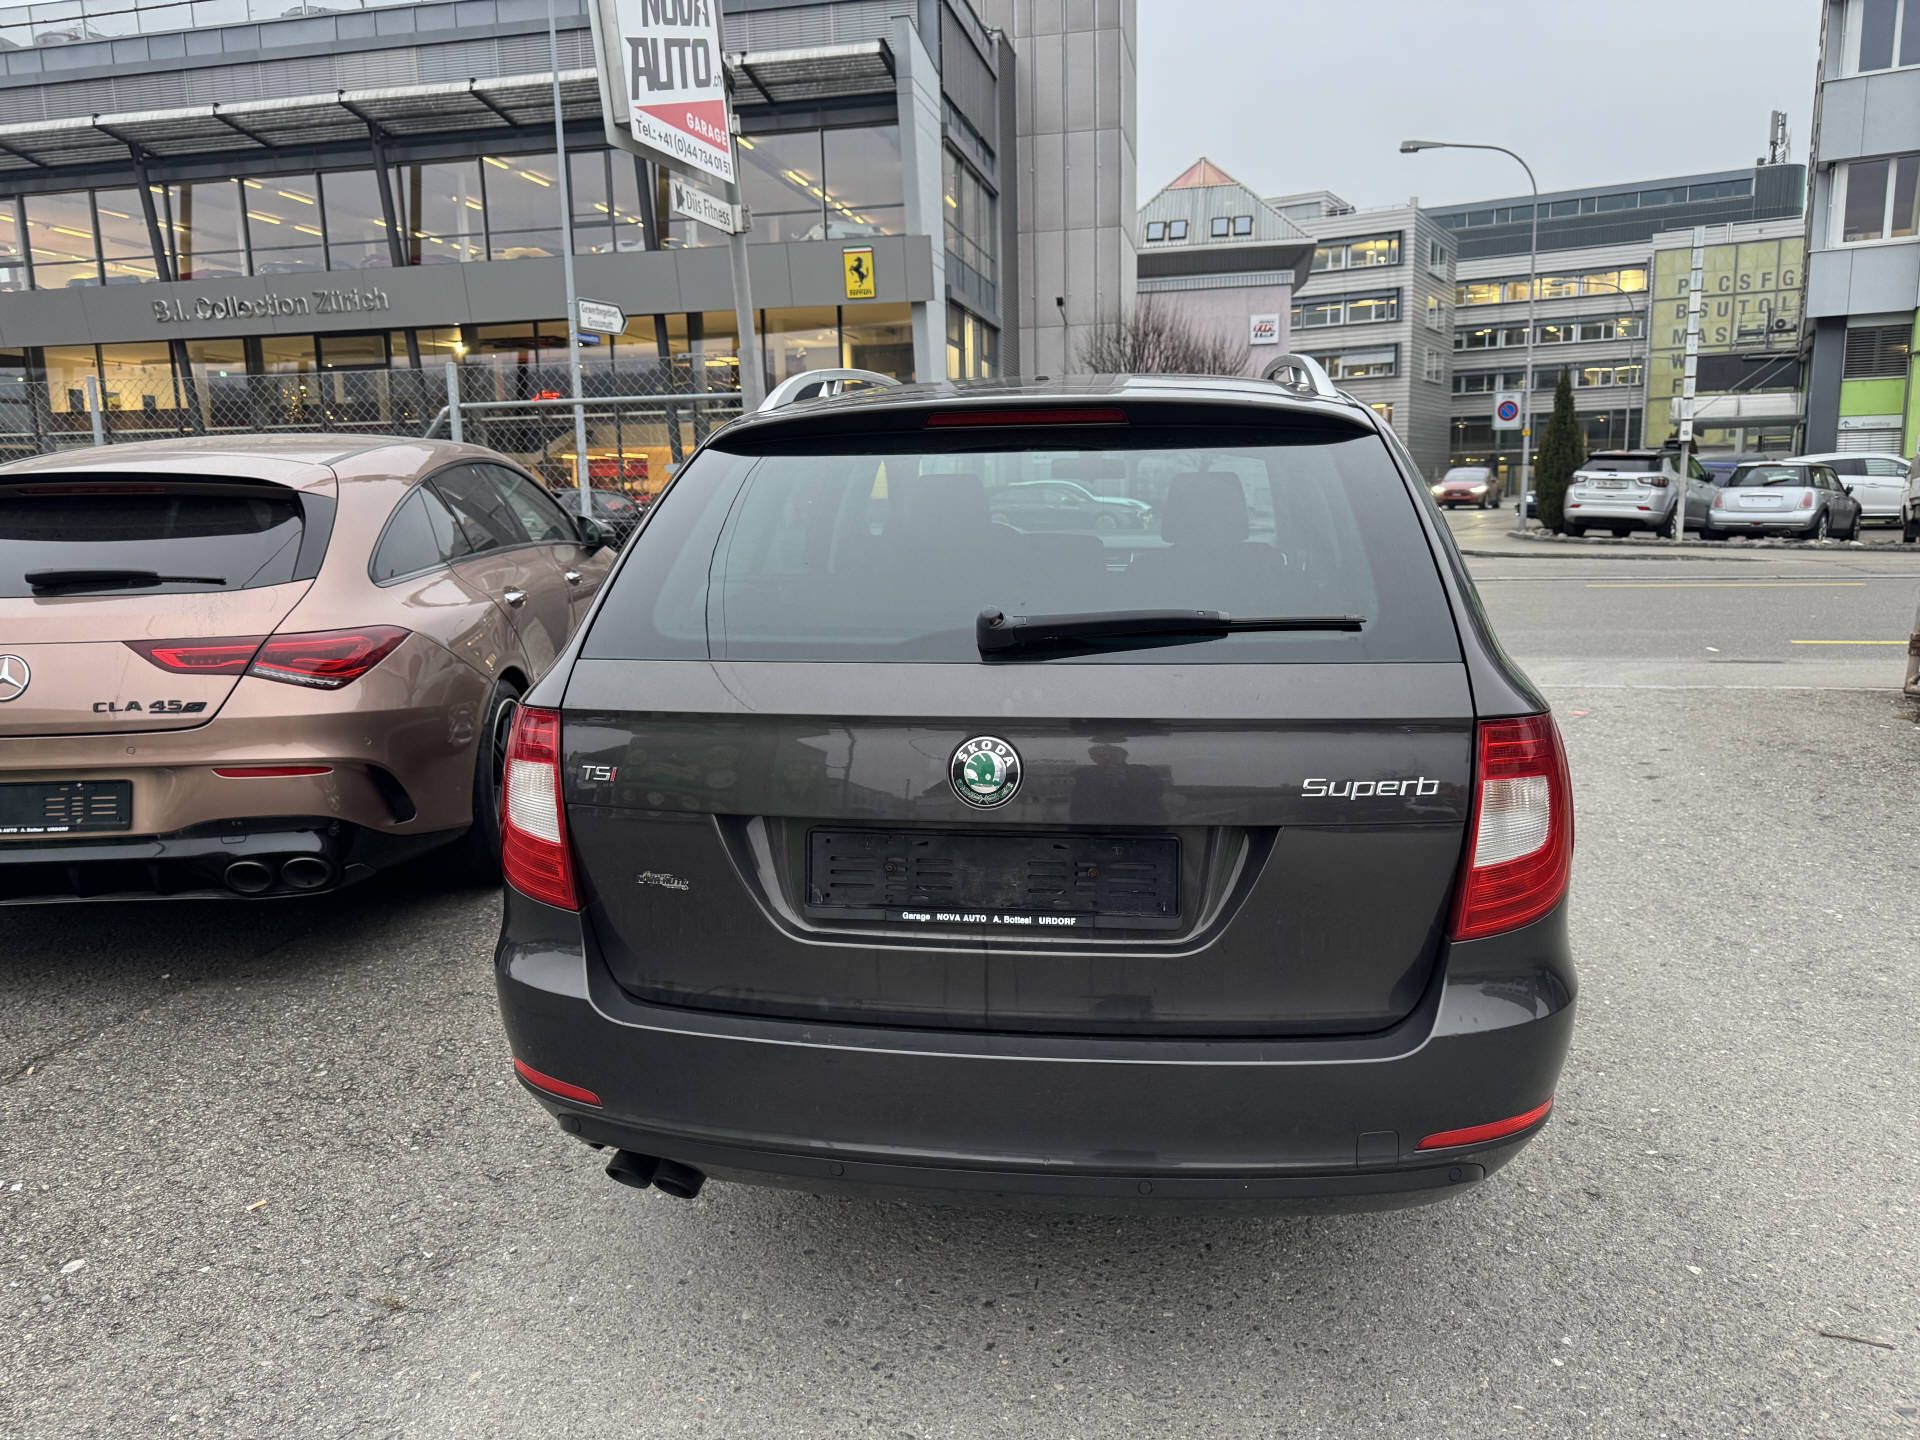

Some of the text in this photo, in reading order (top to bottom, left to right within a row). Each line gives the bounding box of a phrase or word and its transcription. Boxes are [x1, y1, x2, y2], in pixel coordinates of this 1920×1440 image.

[657, 131, 673, 151] +41
[686, 112, 728, 148] GARAGE
[703, 198, 731, 227] Fitness
[194, 294, 310, 320] Collection
[312, 287, 390, 315] Zürich
[92, 700, 142, 713] CLA
[1301, 776, 1441, 801] Superb
[902, 911, 931, 922] Garage
[937, 913, 961, 922] NOVA
[963, 913, 987, 923] AUTO
[992, 914, 1002, 923] A.
[1038, 916, 1077, 926] URDORF
